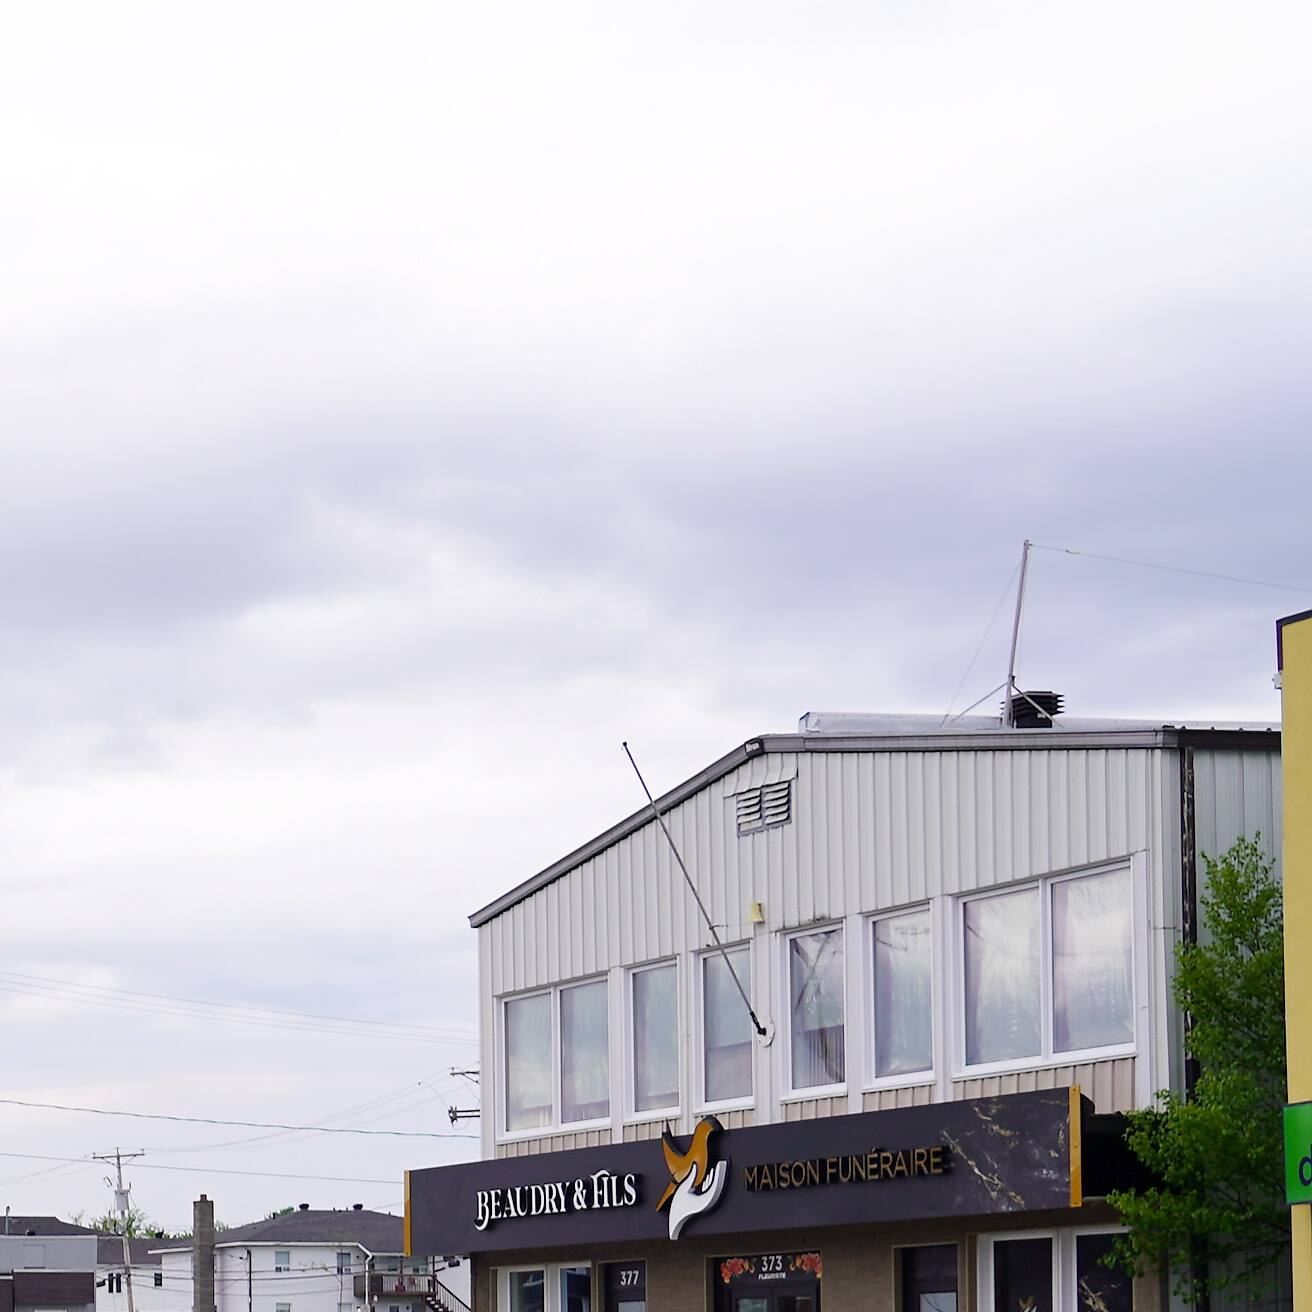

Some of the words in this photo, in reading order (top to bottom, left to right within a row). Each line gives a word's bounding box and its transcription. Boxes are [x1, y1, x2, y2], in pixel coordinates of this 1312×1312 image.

[743, 1161, 820, 1191] MAISON
[826, 1147, 943, 1184] FUNÉRAIRE
[474, 1181, 570, 1231] BEAUDRY
[573, 1178, 588, 1211] &
[590, 1169, 638, 1209] FILS
[620, 1270, 639, 1286] 377
[761, 1255, 783, 1272] 373
